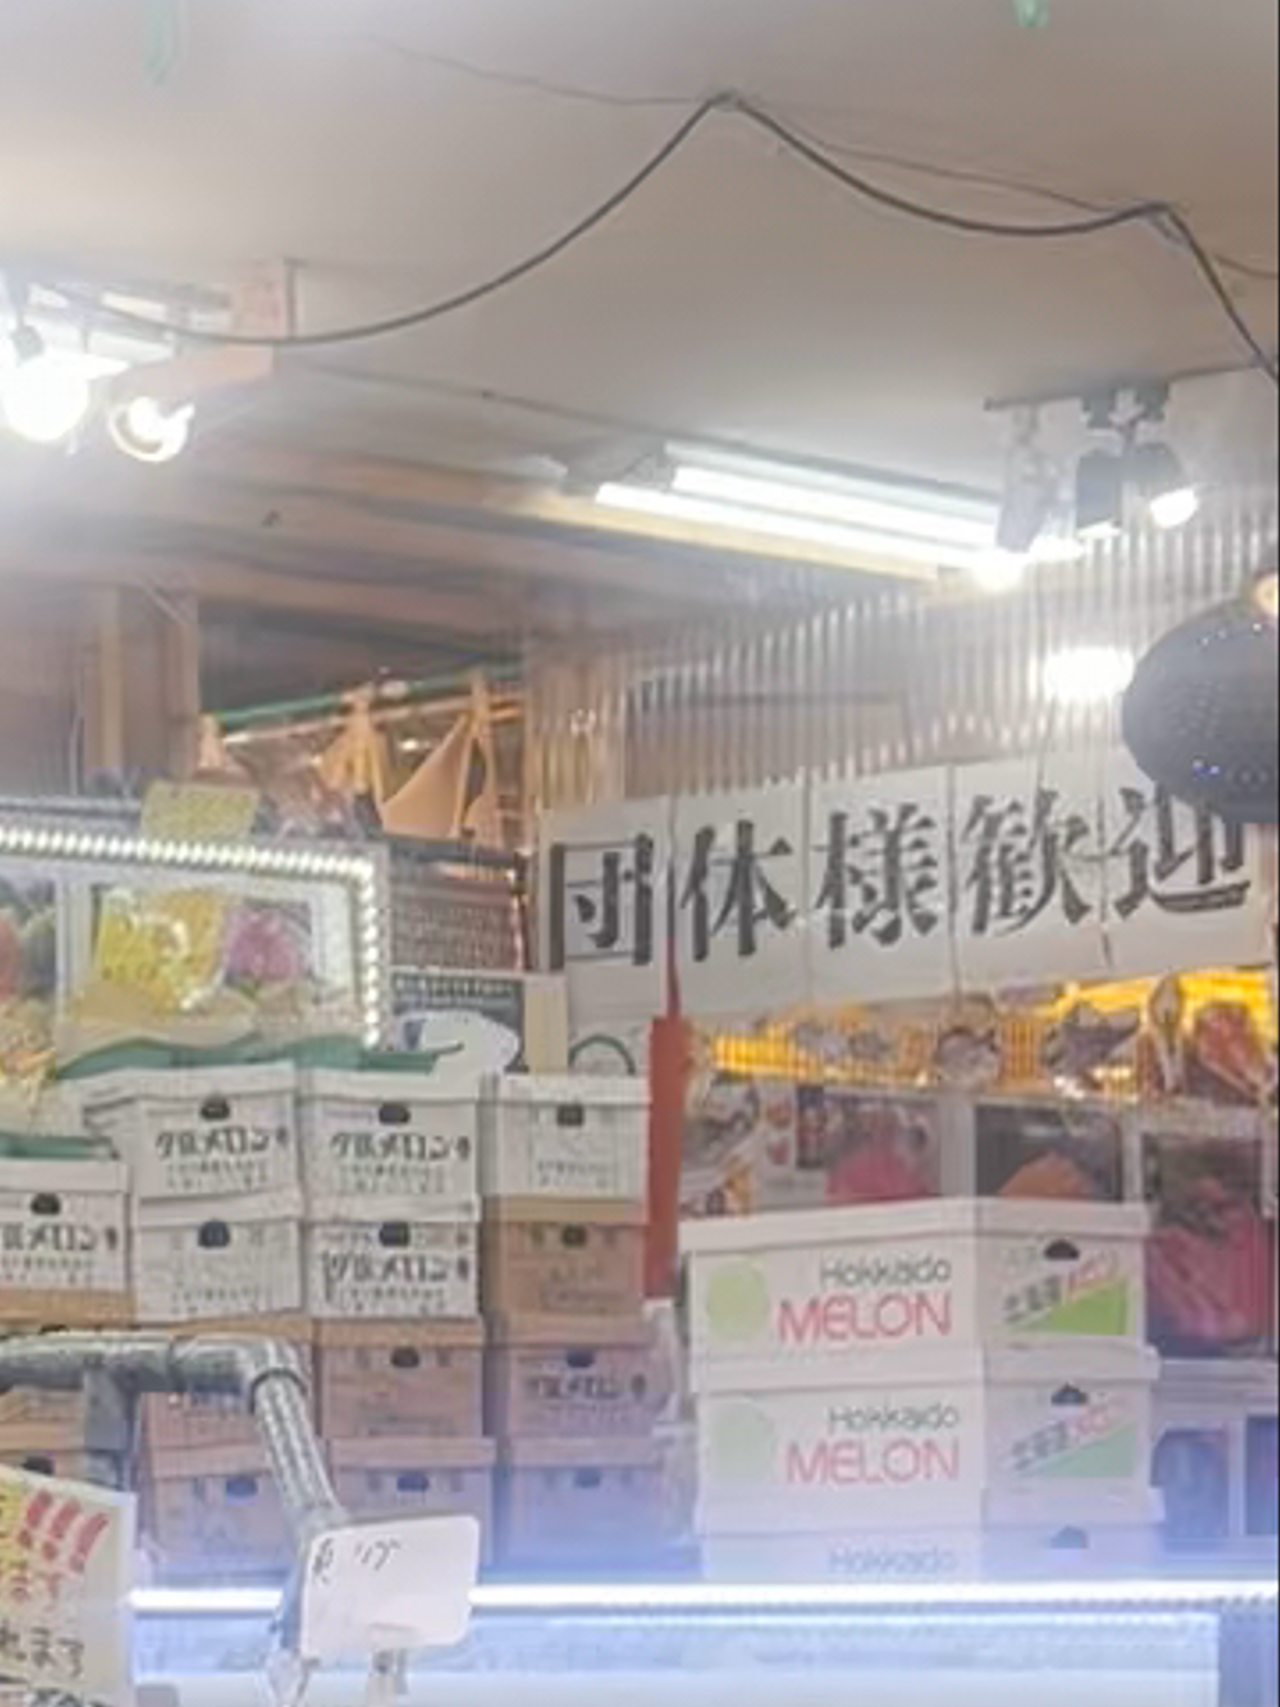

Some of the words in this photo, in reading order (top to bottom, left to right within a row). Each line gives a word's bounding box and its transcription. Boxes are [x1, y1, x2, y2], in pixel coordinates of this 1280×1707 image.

[548, 785, 1251, 970] 団体様歓迎
[819, 1254, 952, 1288] Hokkaido
[777, 1293, 952, 1344] MELON
[828, 1403, 959, 1434] Hokkaido
[786, 1439, 960, 1487] MELON
